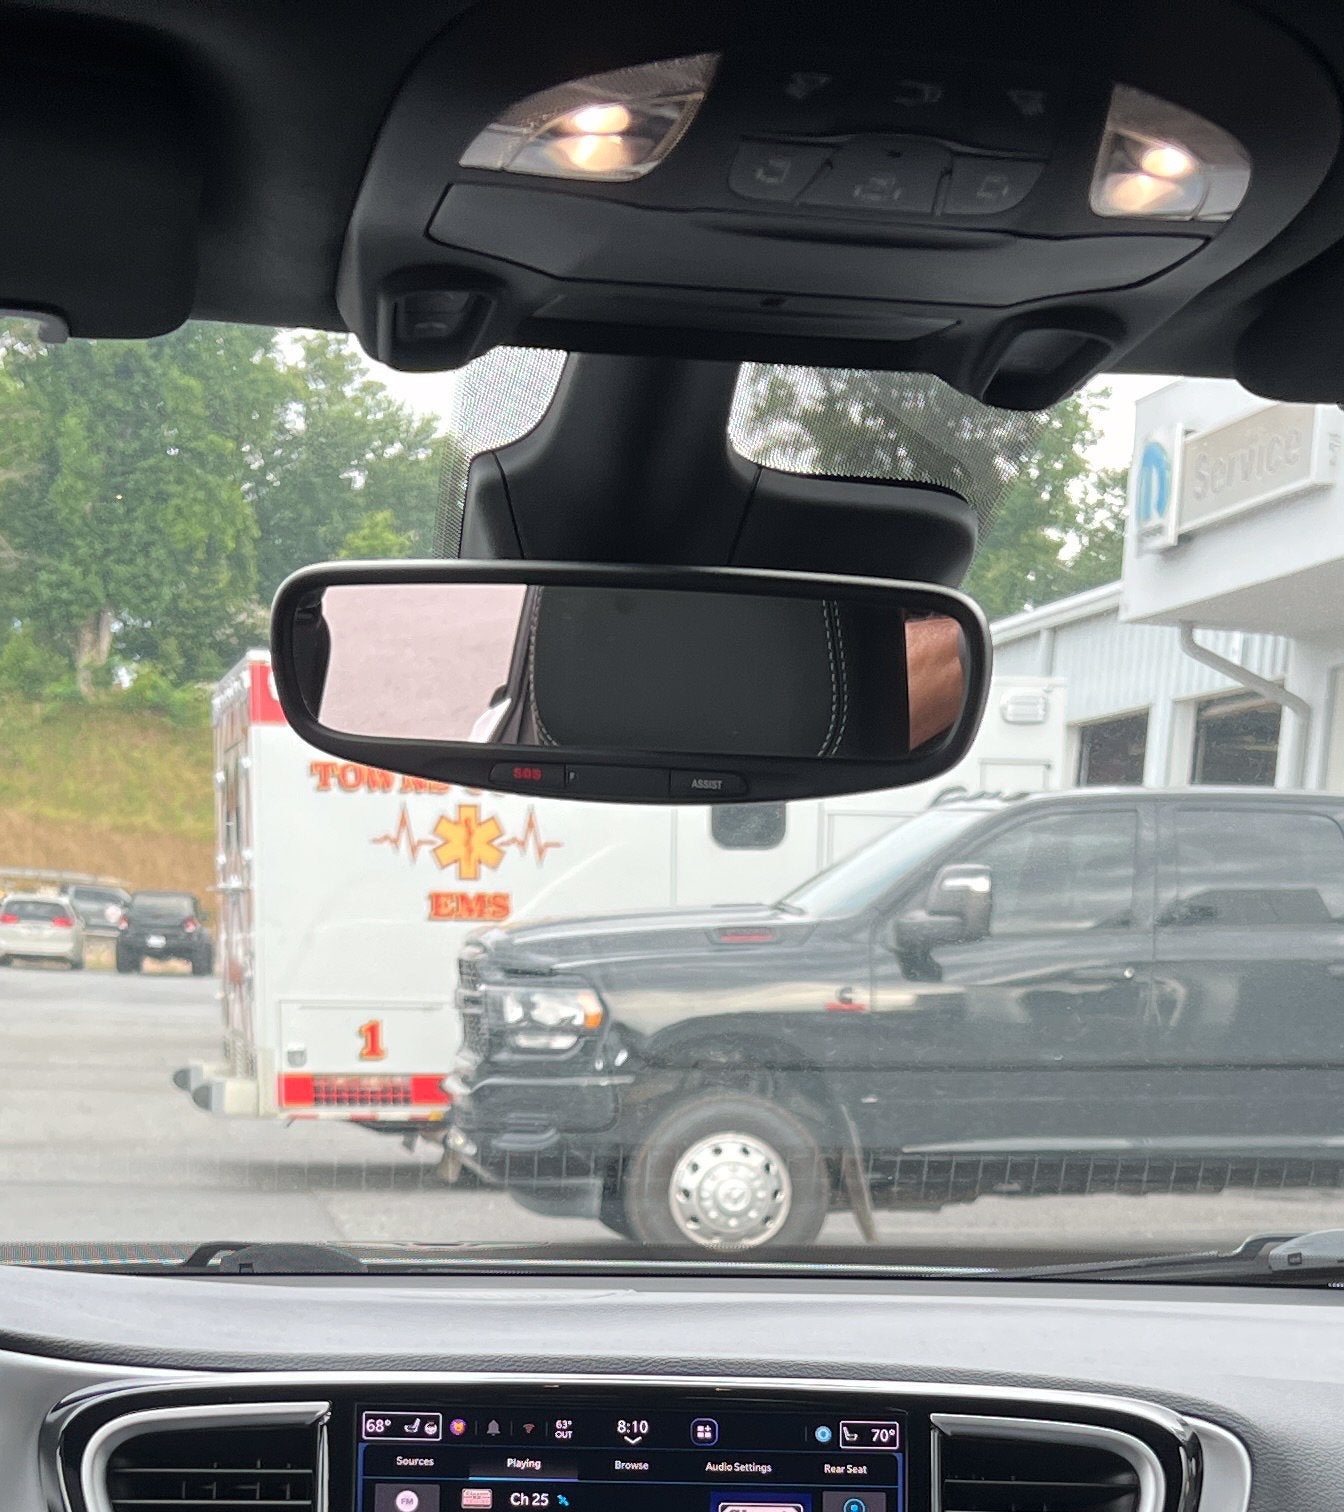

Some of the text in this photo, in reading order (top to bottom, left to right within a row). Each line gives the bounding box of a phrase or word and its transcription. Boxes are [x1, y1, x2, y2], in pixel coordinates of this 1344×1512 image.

[1193, 430, 1303, 500] Service
[513, 767, 542, 781] SOS
[691, 778, 723, 790] ASSIST
[428, 892, 512, 921] EMS
[358, 1019, 388, 1061] 1
[617, 1420, 648, 1434] 8:10
[396, 1456, 434, 1467] Sources
[507, 1458, 541, 1471] Playing
[615, 1460, 649, 1471] Browse
[705, 1461, 772, 1474] Audio Settings
[824, 1464, 867, 1475] Rear Seat
[510, 1492, 549, 1506] Ch 25
